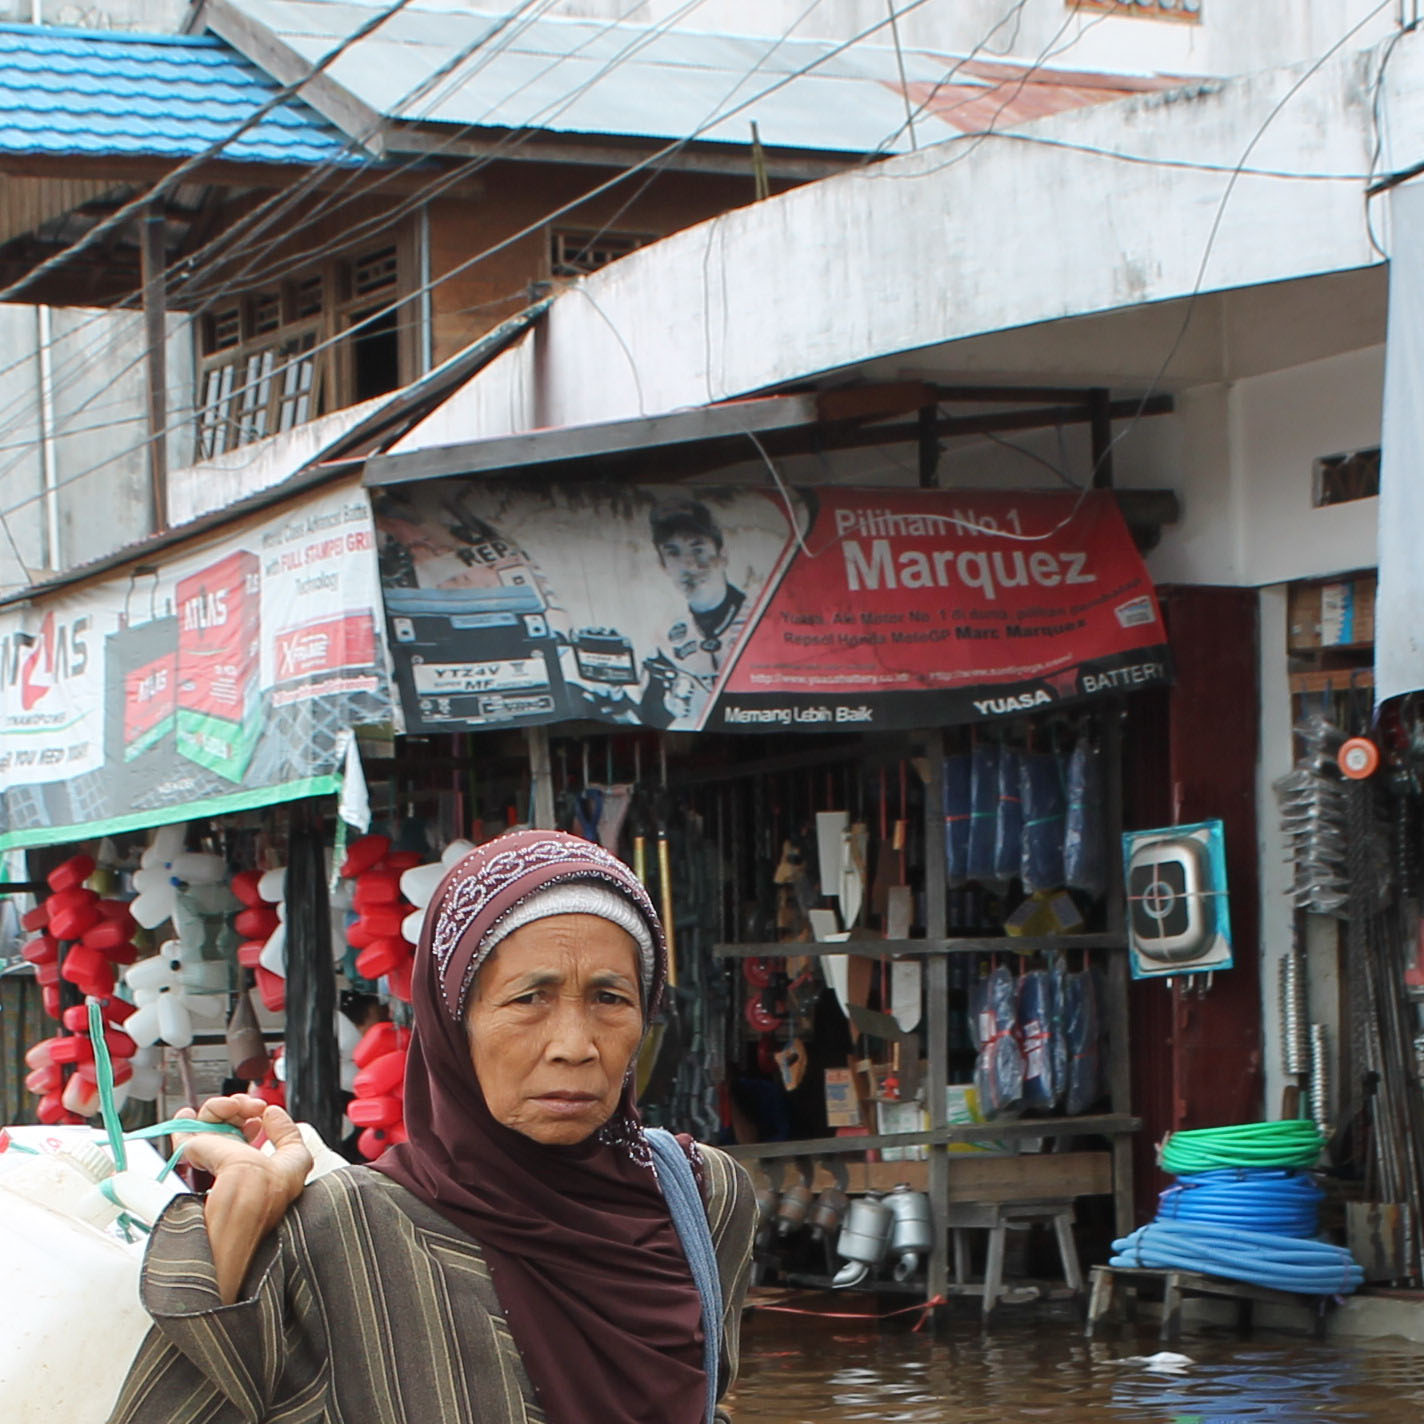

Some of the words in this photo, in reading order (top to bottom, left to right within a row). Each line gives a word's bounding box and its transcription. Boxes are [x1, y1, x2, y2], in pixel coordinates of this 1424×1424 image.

[834, 508, 947, 538] Pilihan
[954, 508, 1024, 537] No.1
[280, 549, 303, 571] FULL
[840, 539, 1097, 600] Marquez
[183, 589, 230, 632] ATLAS
[861, 611, 904, 625] Motor
[838, 631, 886, 647] Honda
[891, 628, 951, 643] MotoGP
[956, 625, 1000, 640] Marc
[1005, 619, 1087, 640] Marquez
[1083, 661, 1166, 693] BATTERY
[725, 705, 792, 725] Memang
[793, 707, 832, 722] Lebih
[835, 705, 874, 722] Baik
[974, 688, 1053, 717] YUASA
